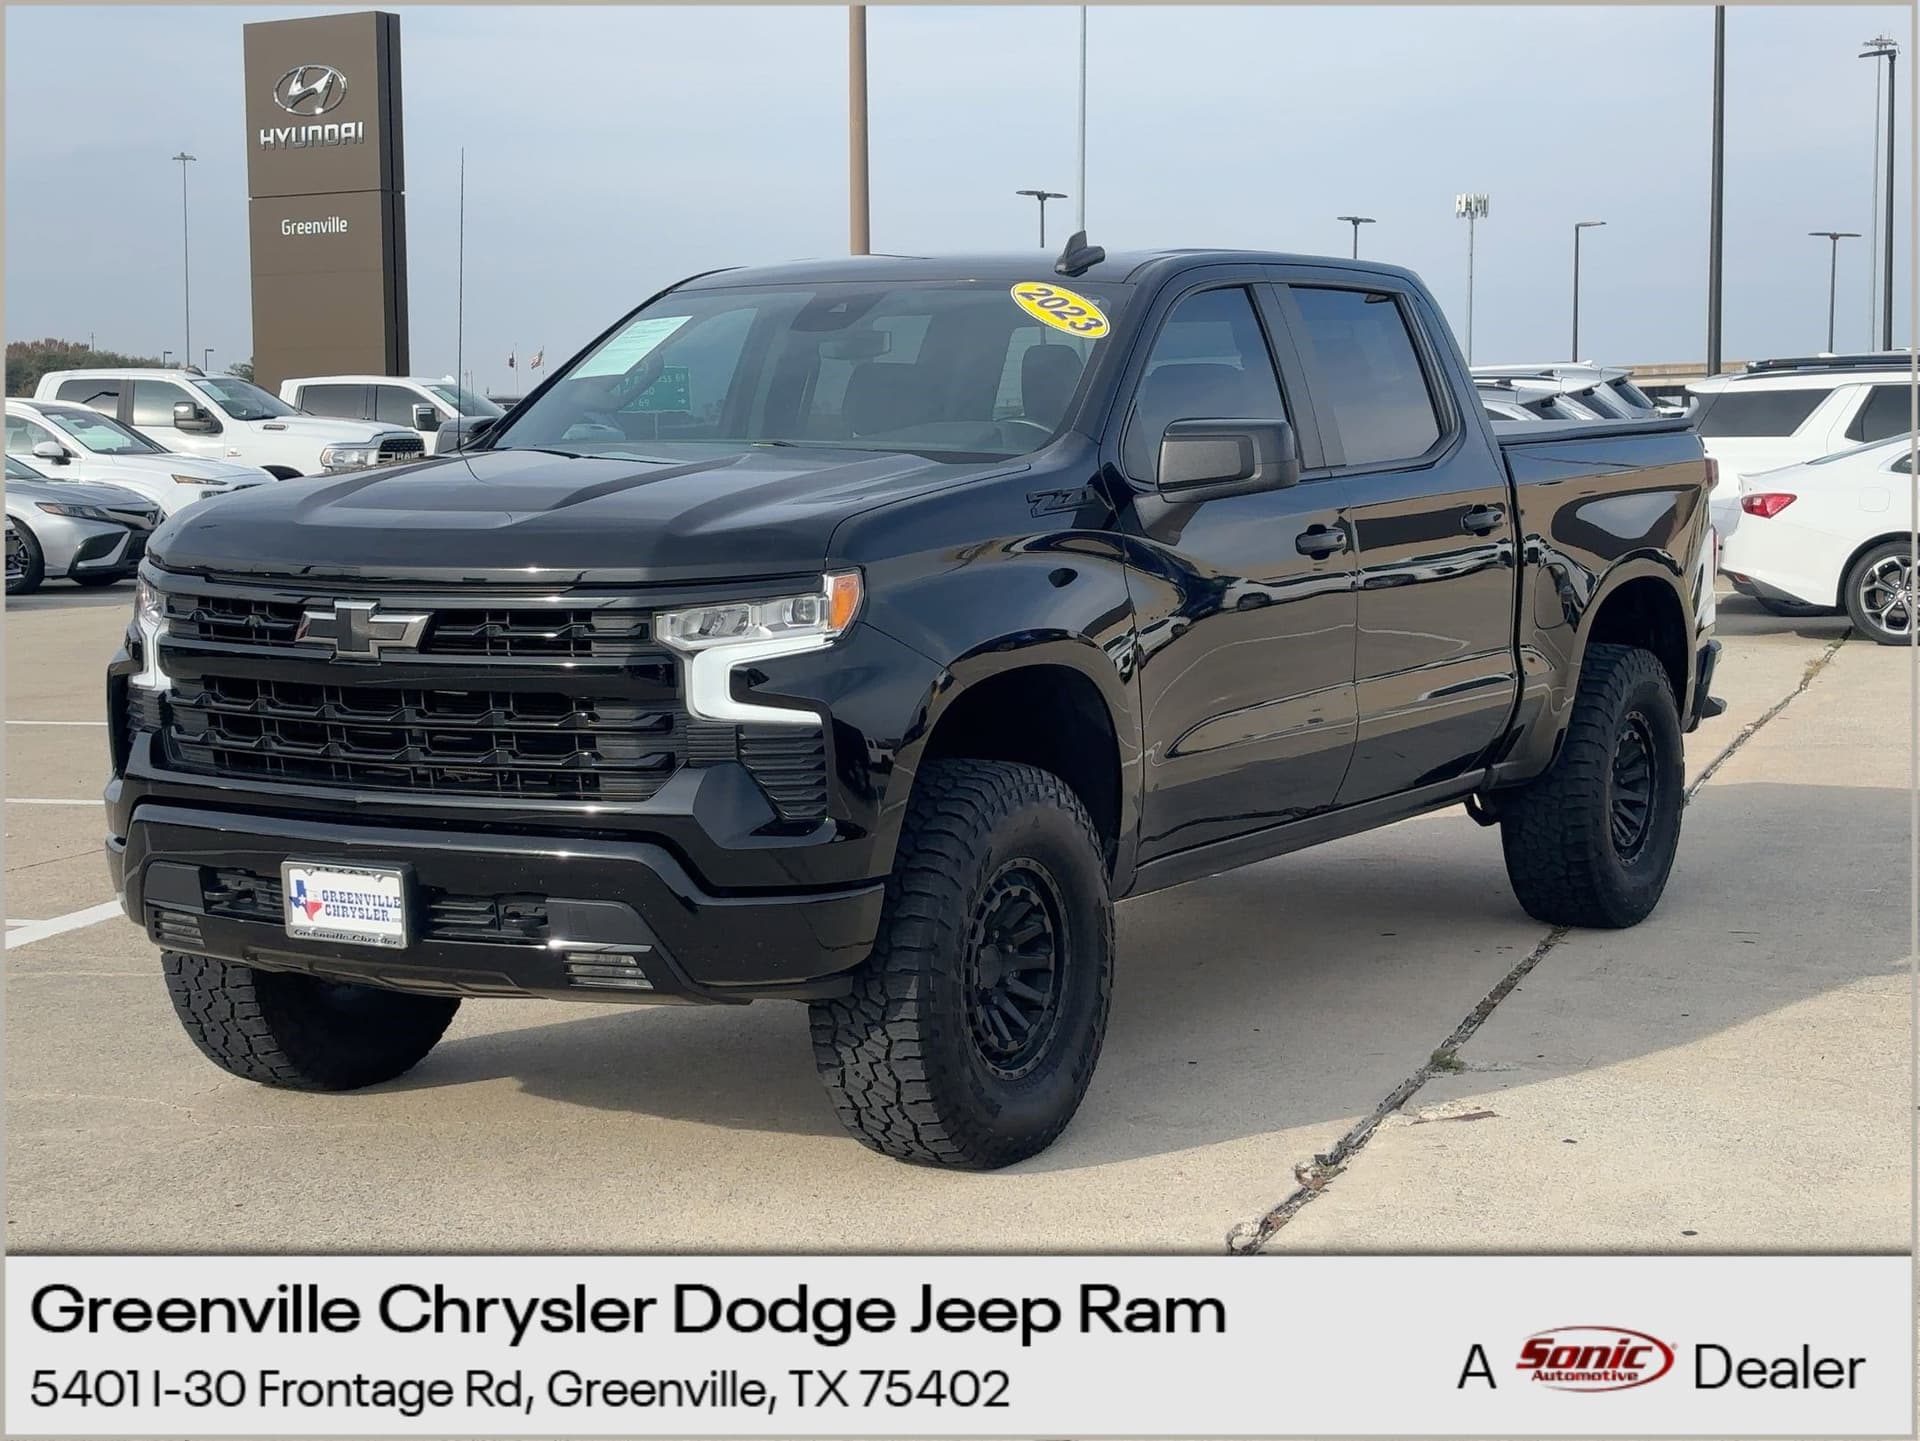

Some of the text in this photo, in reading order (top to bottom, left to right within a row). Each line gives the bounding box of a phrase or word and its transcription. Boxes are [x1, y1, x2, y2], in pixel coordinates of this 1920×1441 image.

[259, 121, 364, 148] HYUNDAI
[281, 216, 348, 236] Greenville
[1017, 287, 1103, 331] 2023
[322, 889, 401, 909] GREENVILLE
[325, 904, 390, 922] CHRYSLER
[352, 934, 397, 946] Chryler
